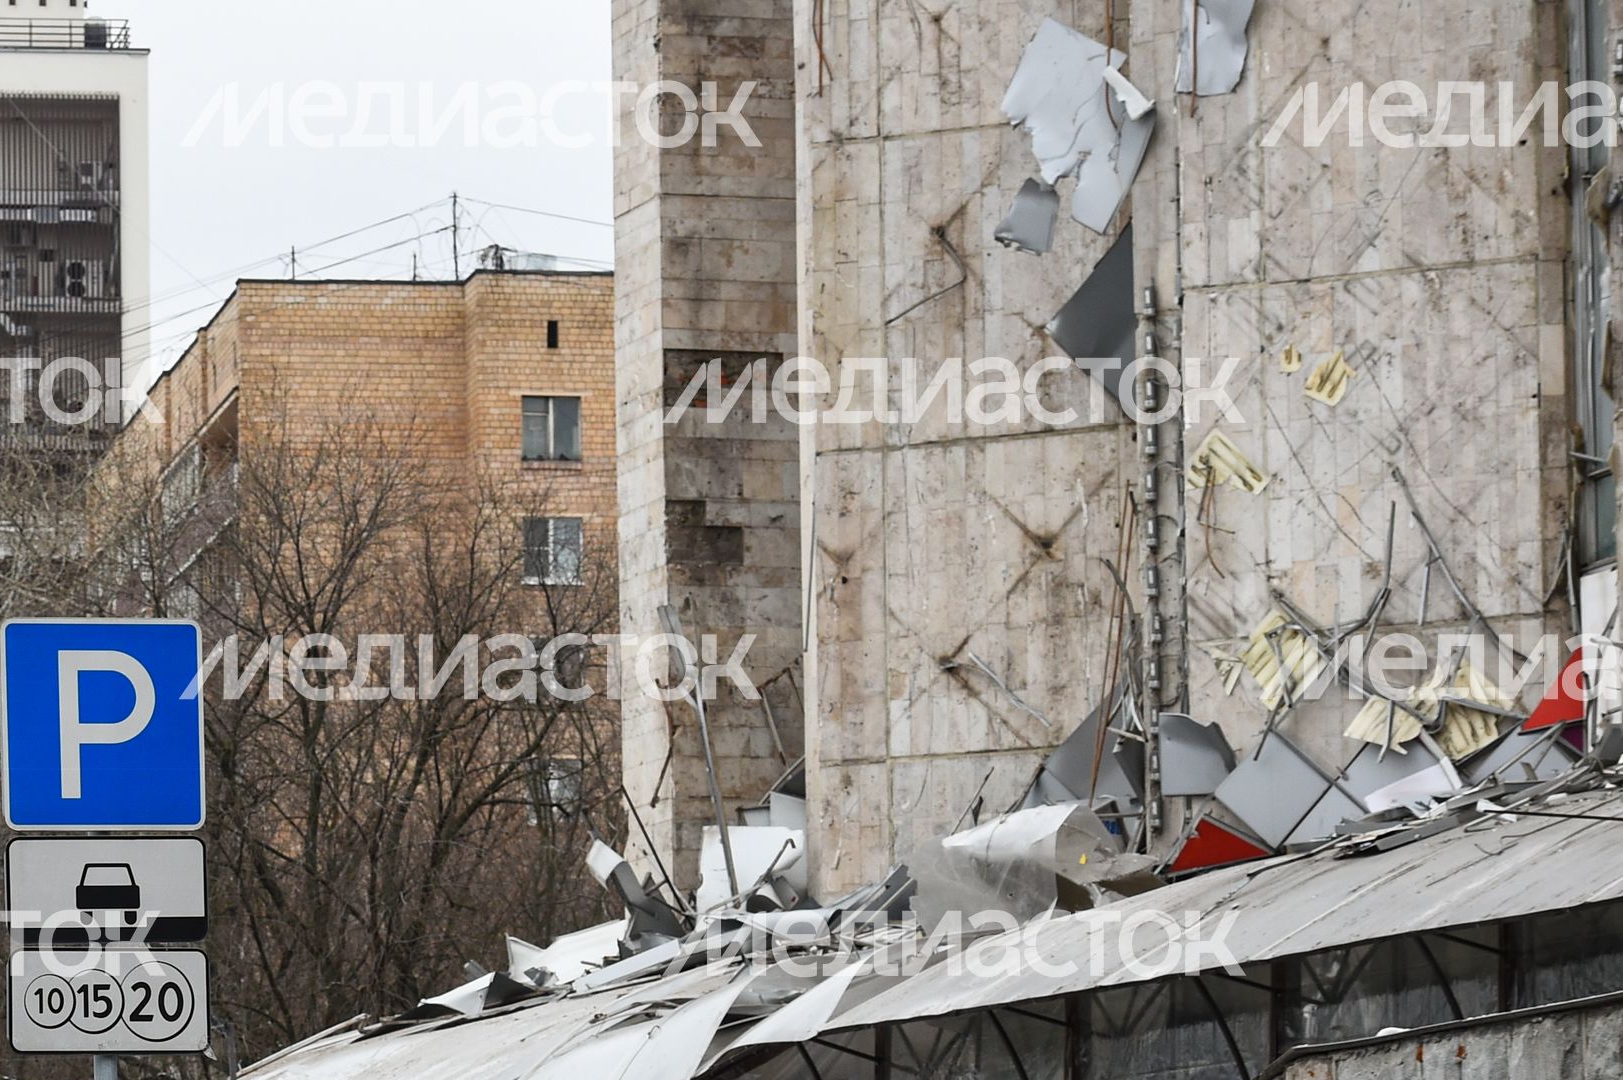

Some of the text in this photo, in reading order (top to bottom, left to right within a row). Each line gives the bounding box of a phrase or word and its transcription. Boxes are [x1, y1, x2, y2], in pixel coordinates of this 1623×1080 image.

[58, 650, 155, 798] P
[34, 981, 184, 1021] 10 15 20
